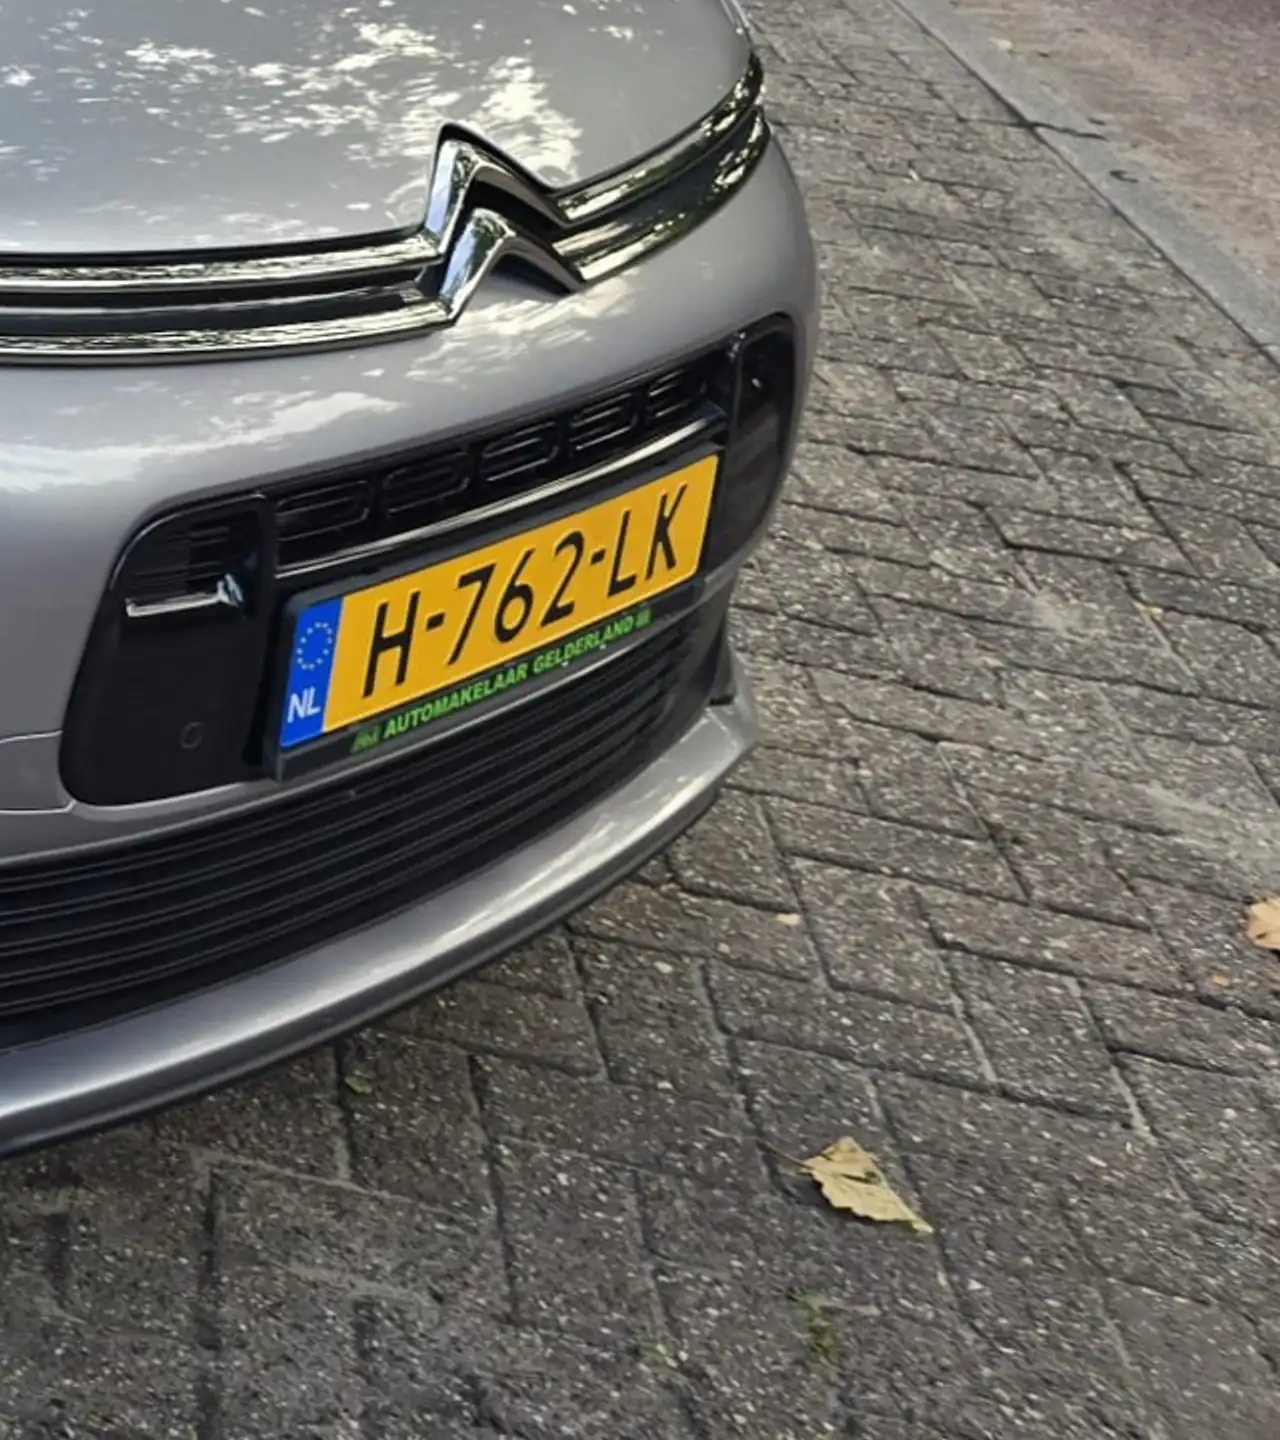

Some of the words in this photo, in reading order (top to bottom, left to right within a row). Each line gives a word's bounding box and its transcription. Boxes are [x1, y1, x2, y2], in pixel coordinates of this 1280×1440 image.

[361, 484, 688, 699] H-762-LK
[287, 686, 320, 723] NL
[383, 663, 528, 740] AUTOMAKELAAR
[531, 610, 634, 675] GELDERLAND
